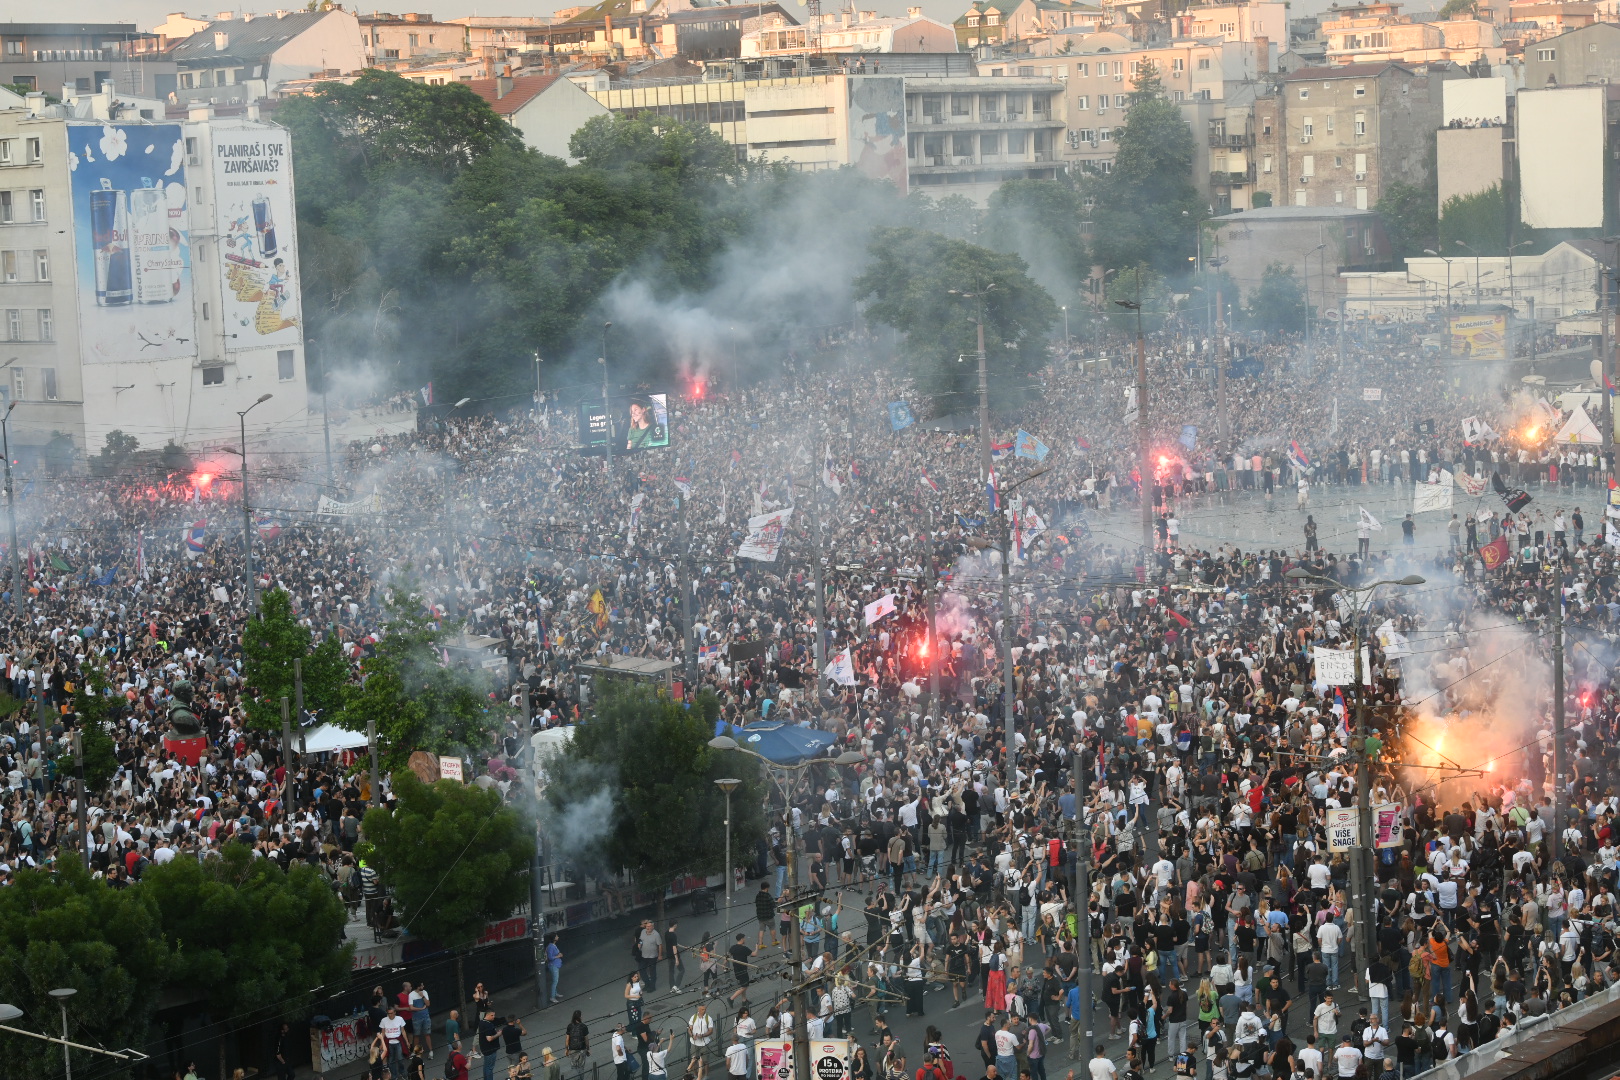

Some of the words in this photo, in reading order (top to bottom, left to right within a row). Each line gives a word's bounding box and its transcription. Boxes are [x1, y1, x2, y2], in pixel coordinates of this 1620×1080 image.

[217, 141, 260, 157] PLANIRAŠ
[262, 143, 266, 156] I
[268, 143, 283, 156] SVE
[223, 157, 279, 173] ZAVRŠAVAŠ?
[168, 209, 181, 217] NOVO
[134, 255, 142, 275] Bull
[1332, 837, 1356, 846] SNAGE
[823, 1058, 833, 1067] 15
